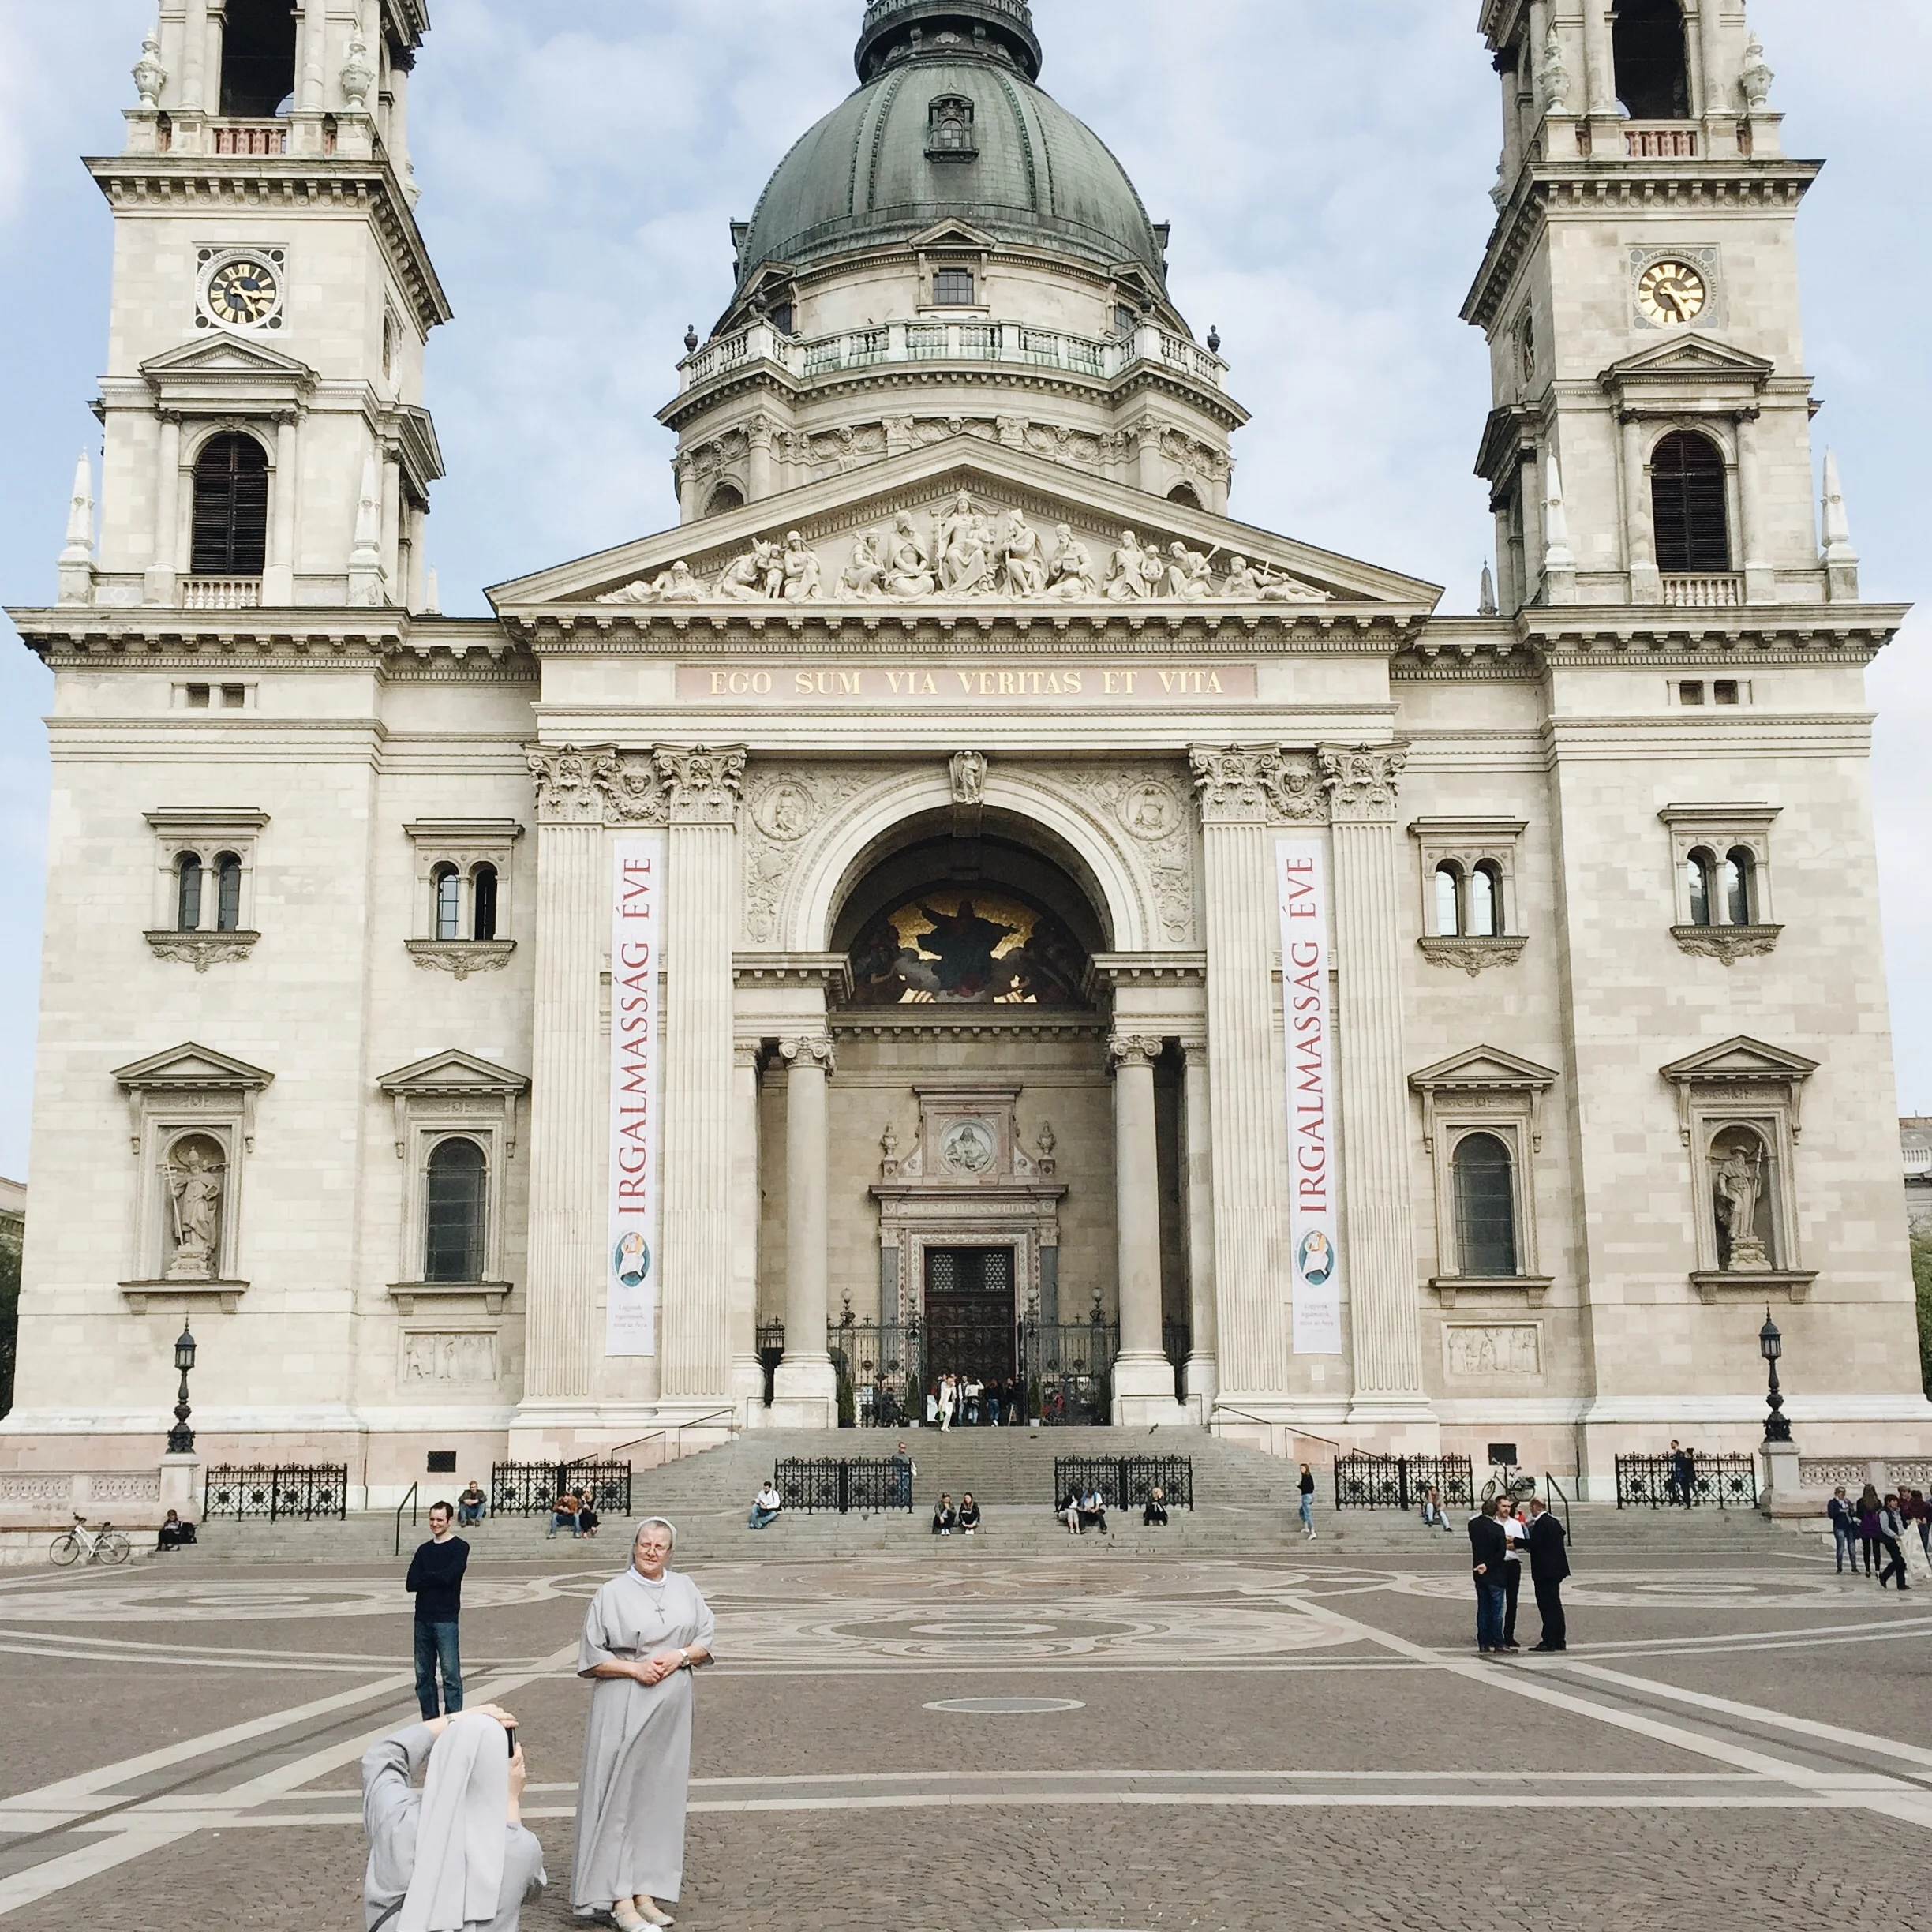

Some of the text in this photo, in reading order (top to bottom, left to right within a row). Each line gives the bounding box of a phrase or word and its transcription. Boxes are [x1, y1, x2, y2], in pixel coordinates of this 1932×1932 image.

[710, 671, 1224, 695] EGO SUM VIA VERITAS ET VITA
[616, 858, 651, 919] ÉVE
[1282, 857, 1316, 919] ÉVE
[614, 942, 650, 1215] IRGALMASSÁG
[1285, 941, 1327, 1213] IRGALMASSÁG
